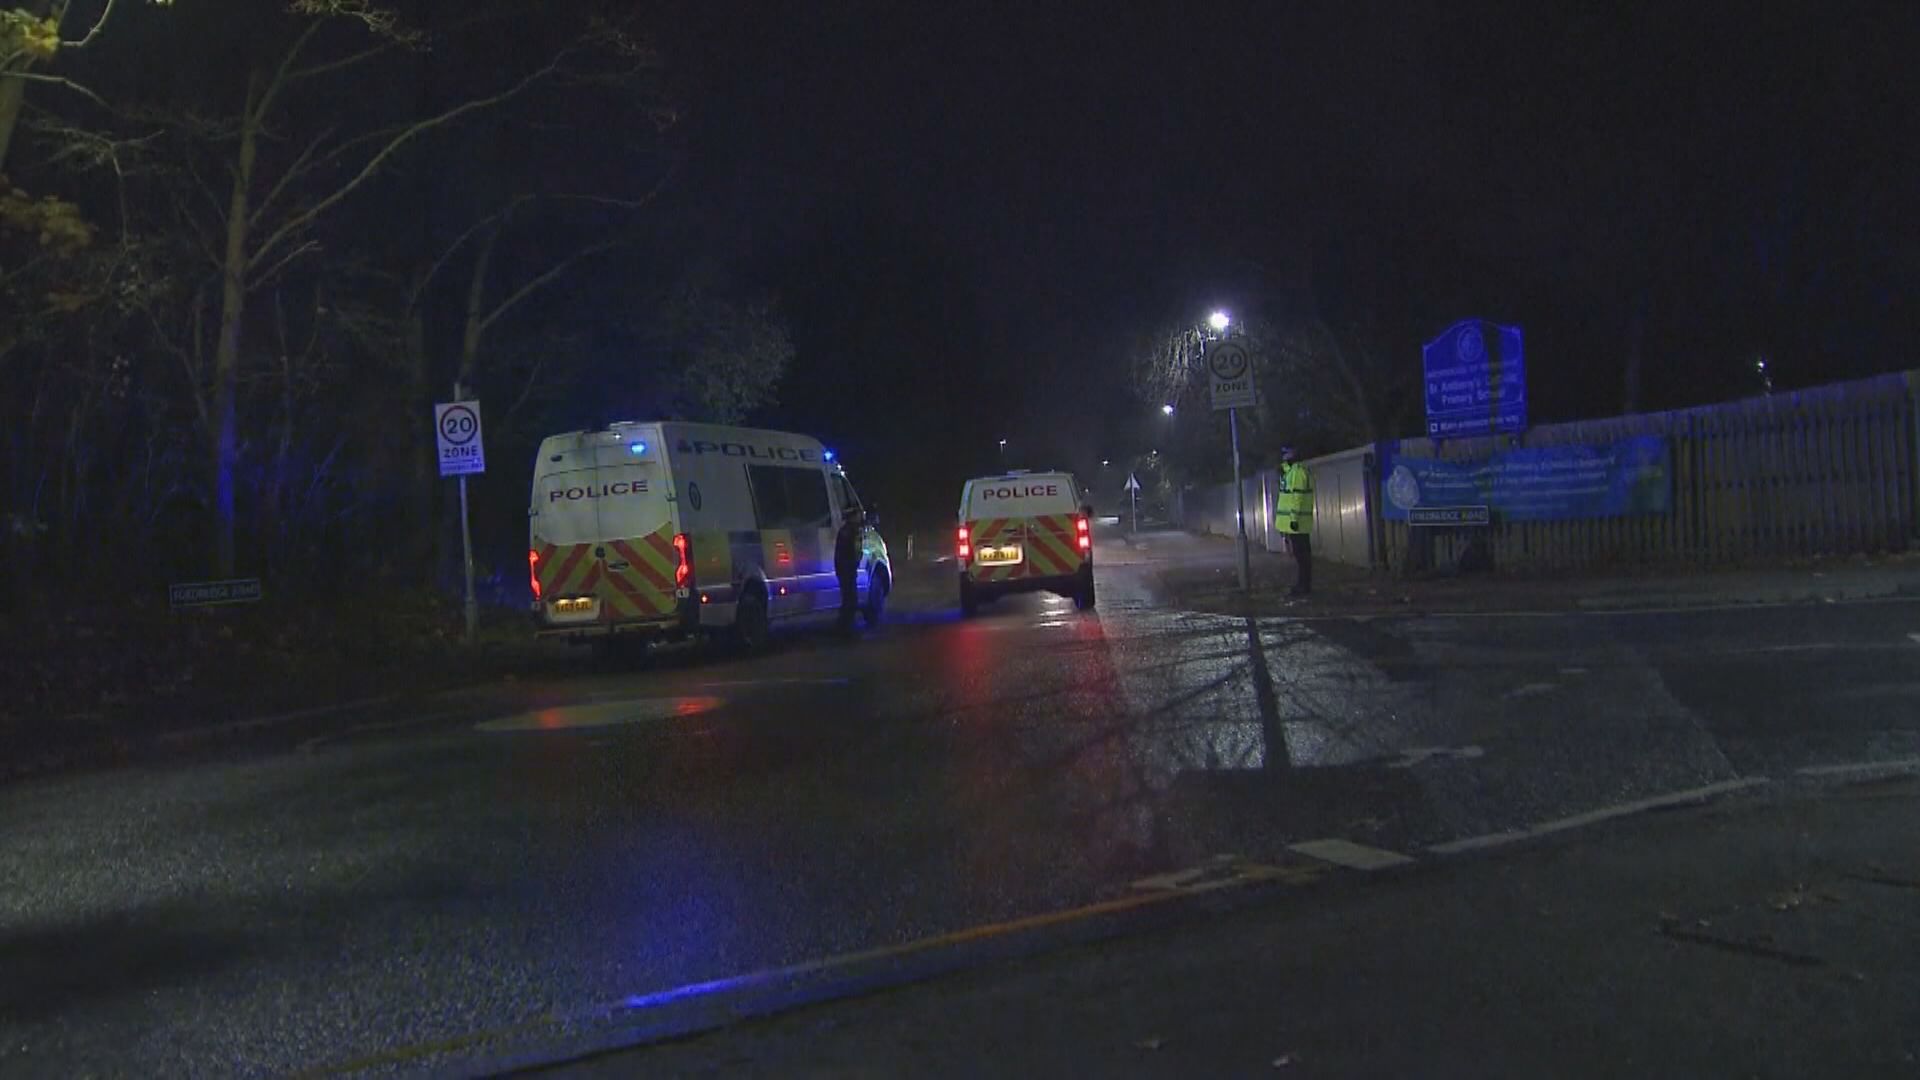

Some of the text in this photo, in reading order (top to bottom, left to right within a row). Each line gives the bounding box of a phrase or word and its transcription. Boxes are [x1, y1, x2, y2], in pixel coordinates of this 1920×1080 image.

[1216, 352, 1243, 370] 20
[1216, 381, 1249, 393] ZONE
[446, 416, 473, 435] 20
[443, 445, 478, 458] ZONE
[693, 440, 818, 462] POLICE
[549, 479, 649, 502] POLICE
[983, 485, 1058, 500] POLICE
